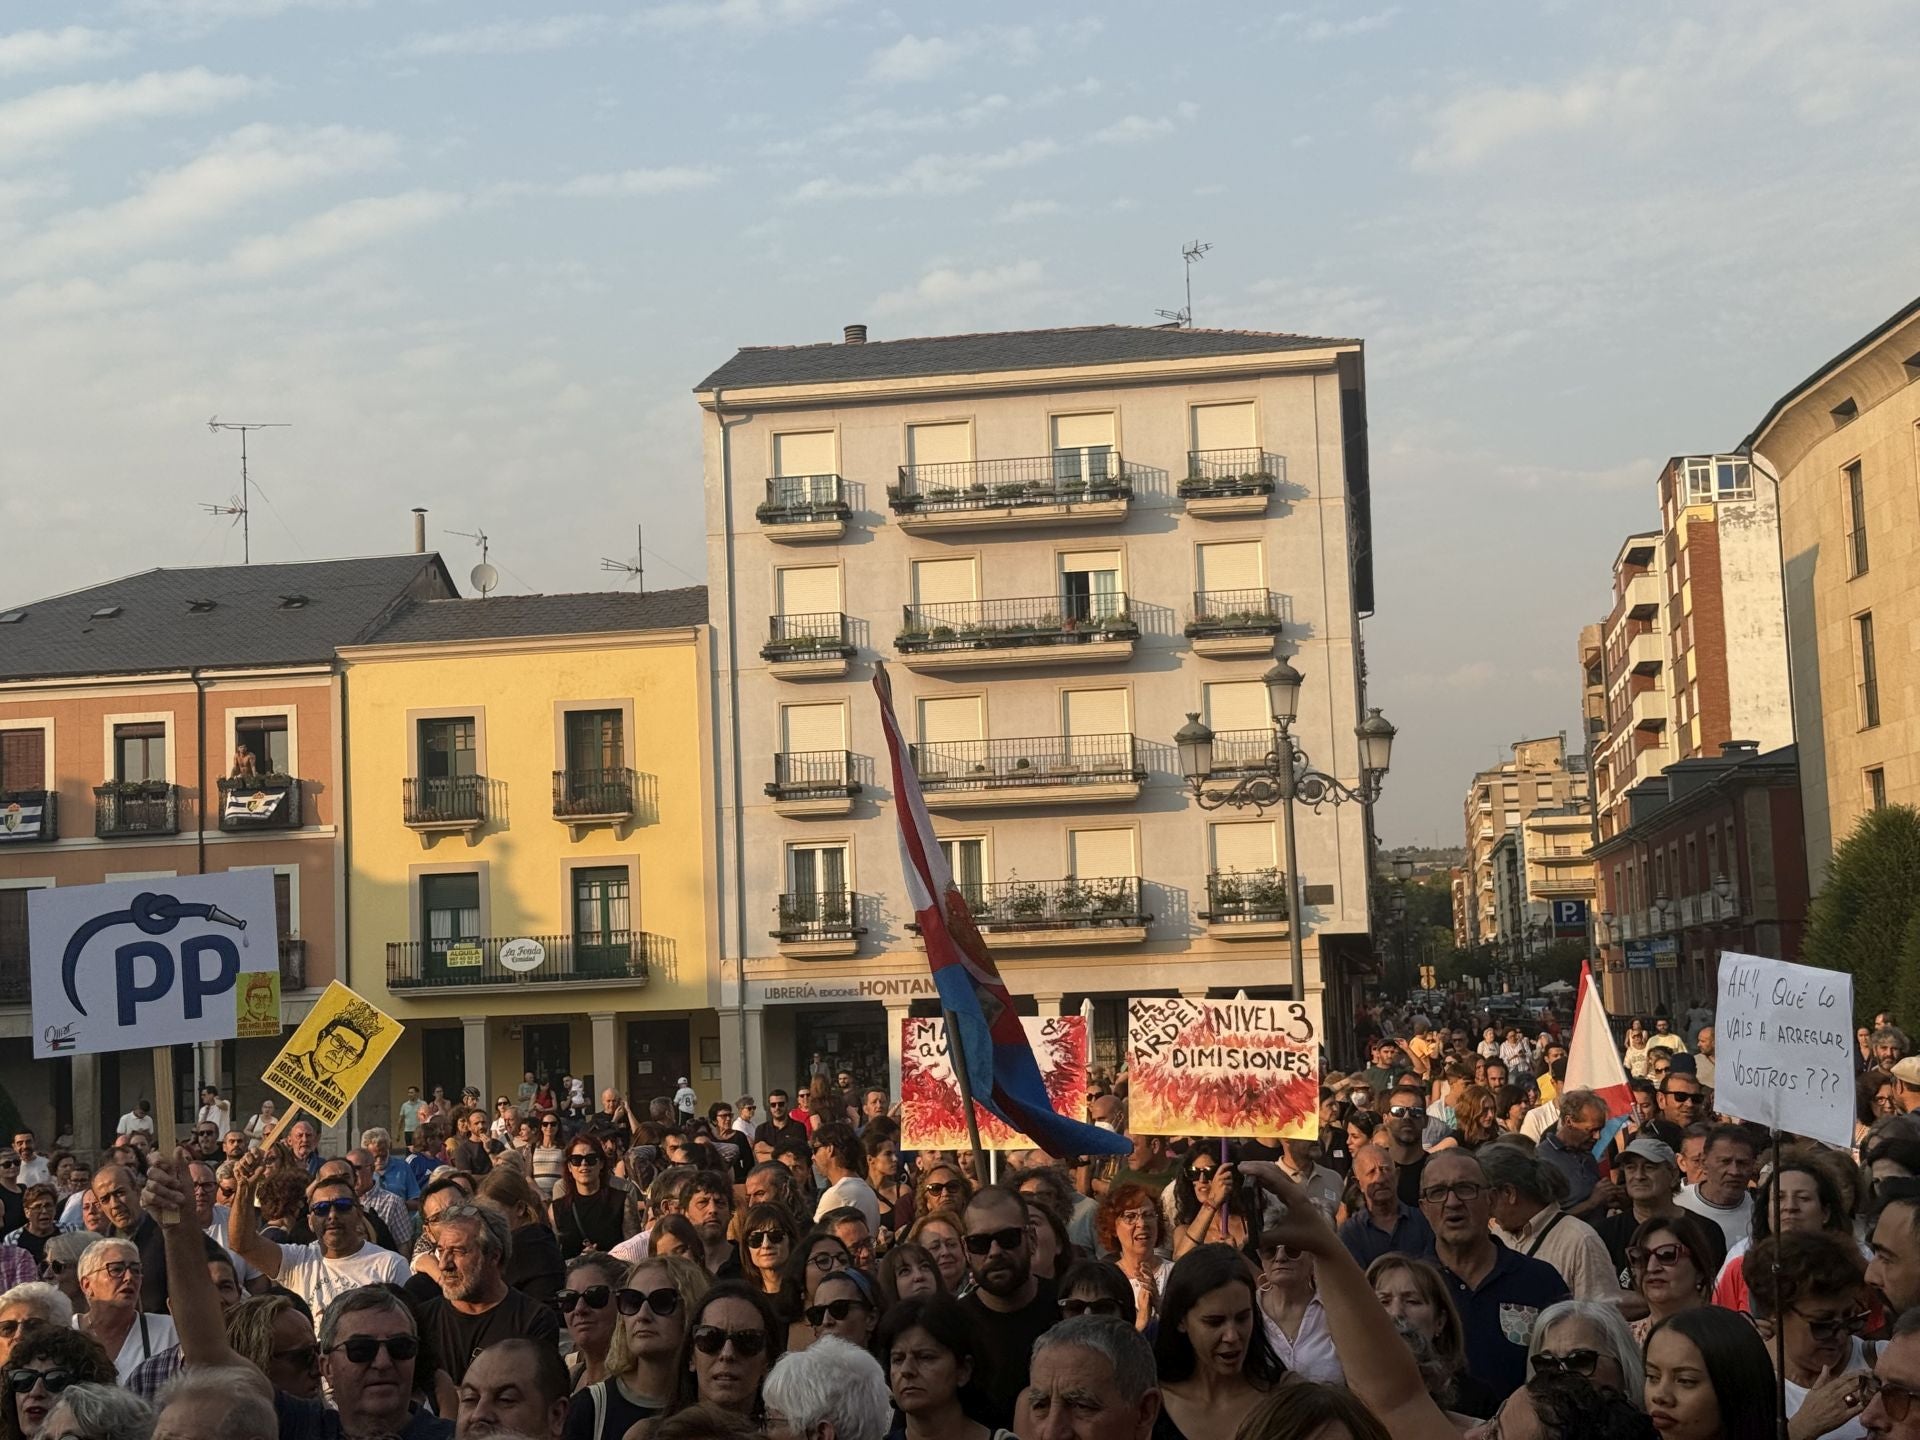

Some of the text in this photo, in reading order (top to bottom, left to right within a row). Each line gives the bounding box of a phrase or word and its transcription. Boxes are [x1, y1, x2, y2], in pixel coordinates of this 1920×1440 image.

[115, 934, 240, 1026] PP
[764, 982, 817, 1000] LIBRERÍA
[819, 988, 859, 998] EDICIONES
[1128, 1000, 1156, 1022] EL
[1130, 999, 1180, 1043] BIERZO
[1214, 1003, 1314, 1043] NIVEL 3
[1172, 1047, 1311, 1079] DIMISIONES
[314, 1086, 345, 1111] ARRANZ
